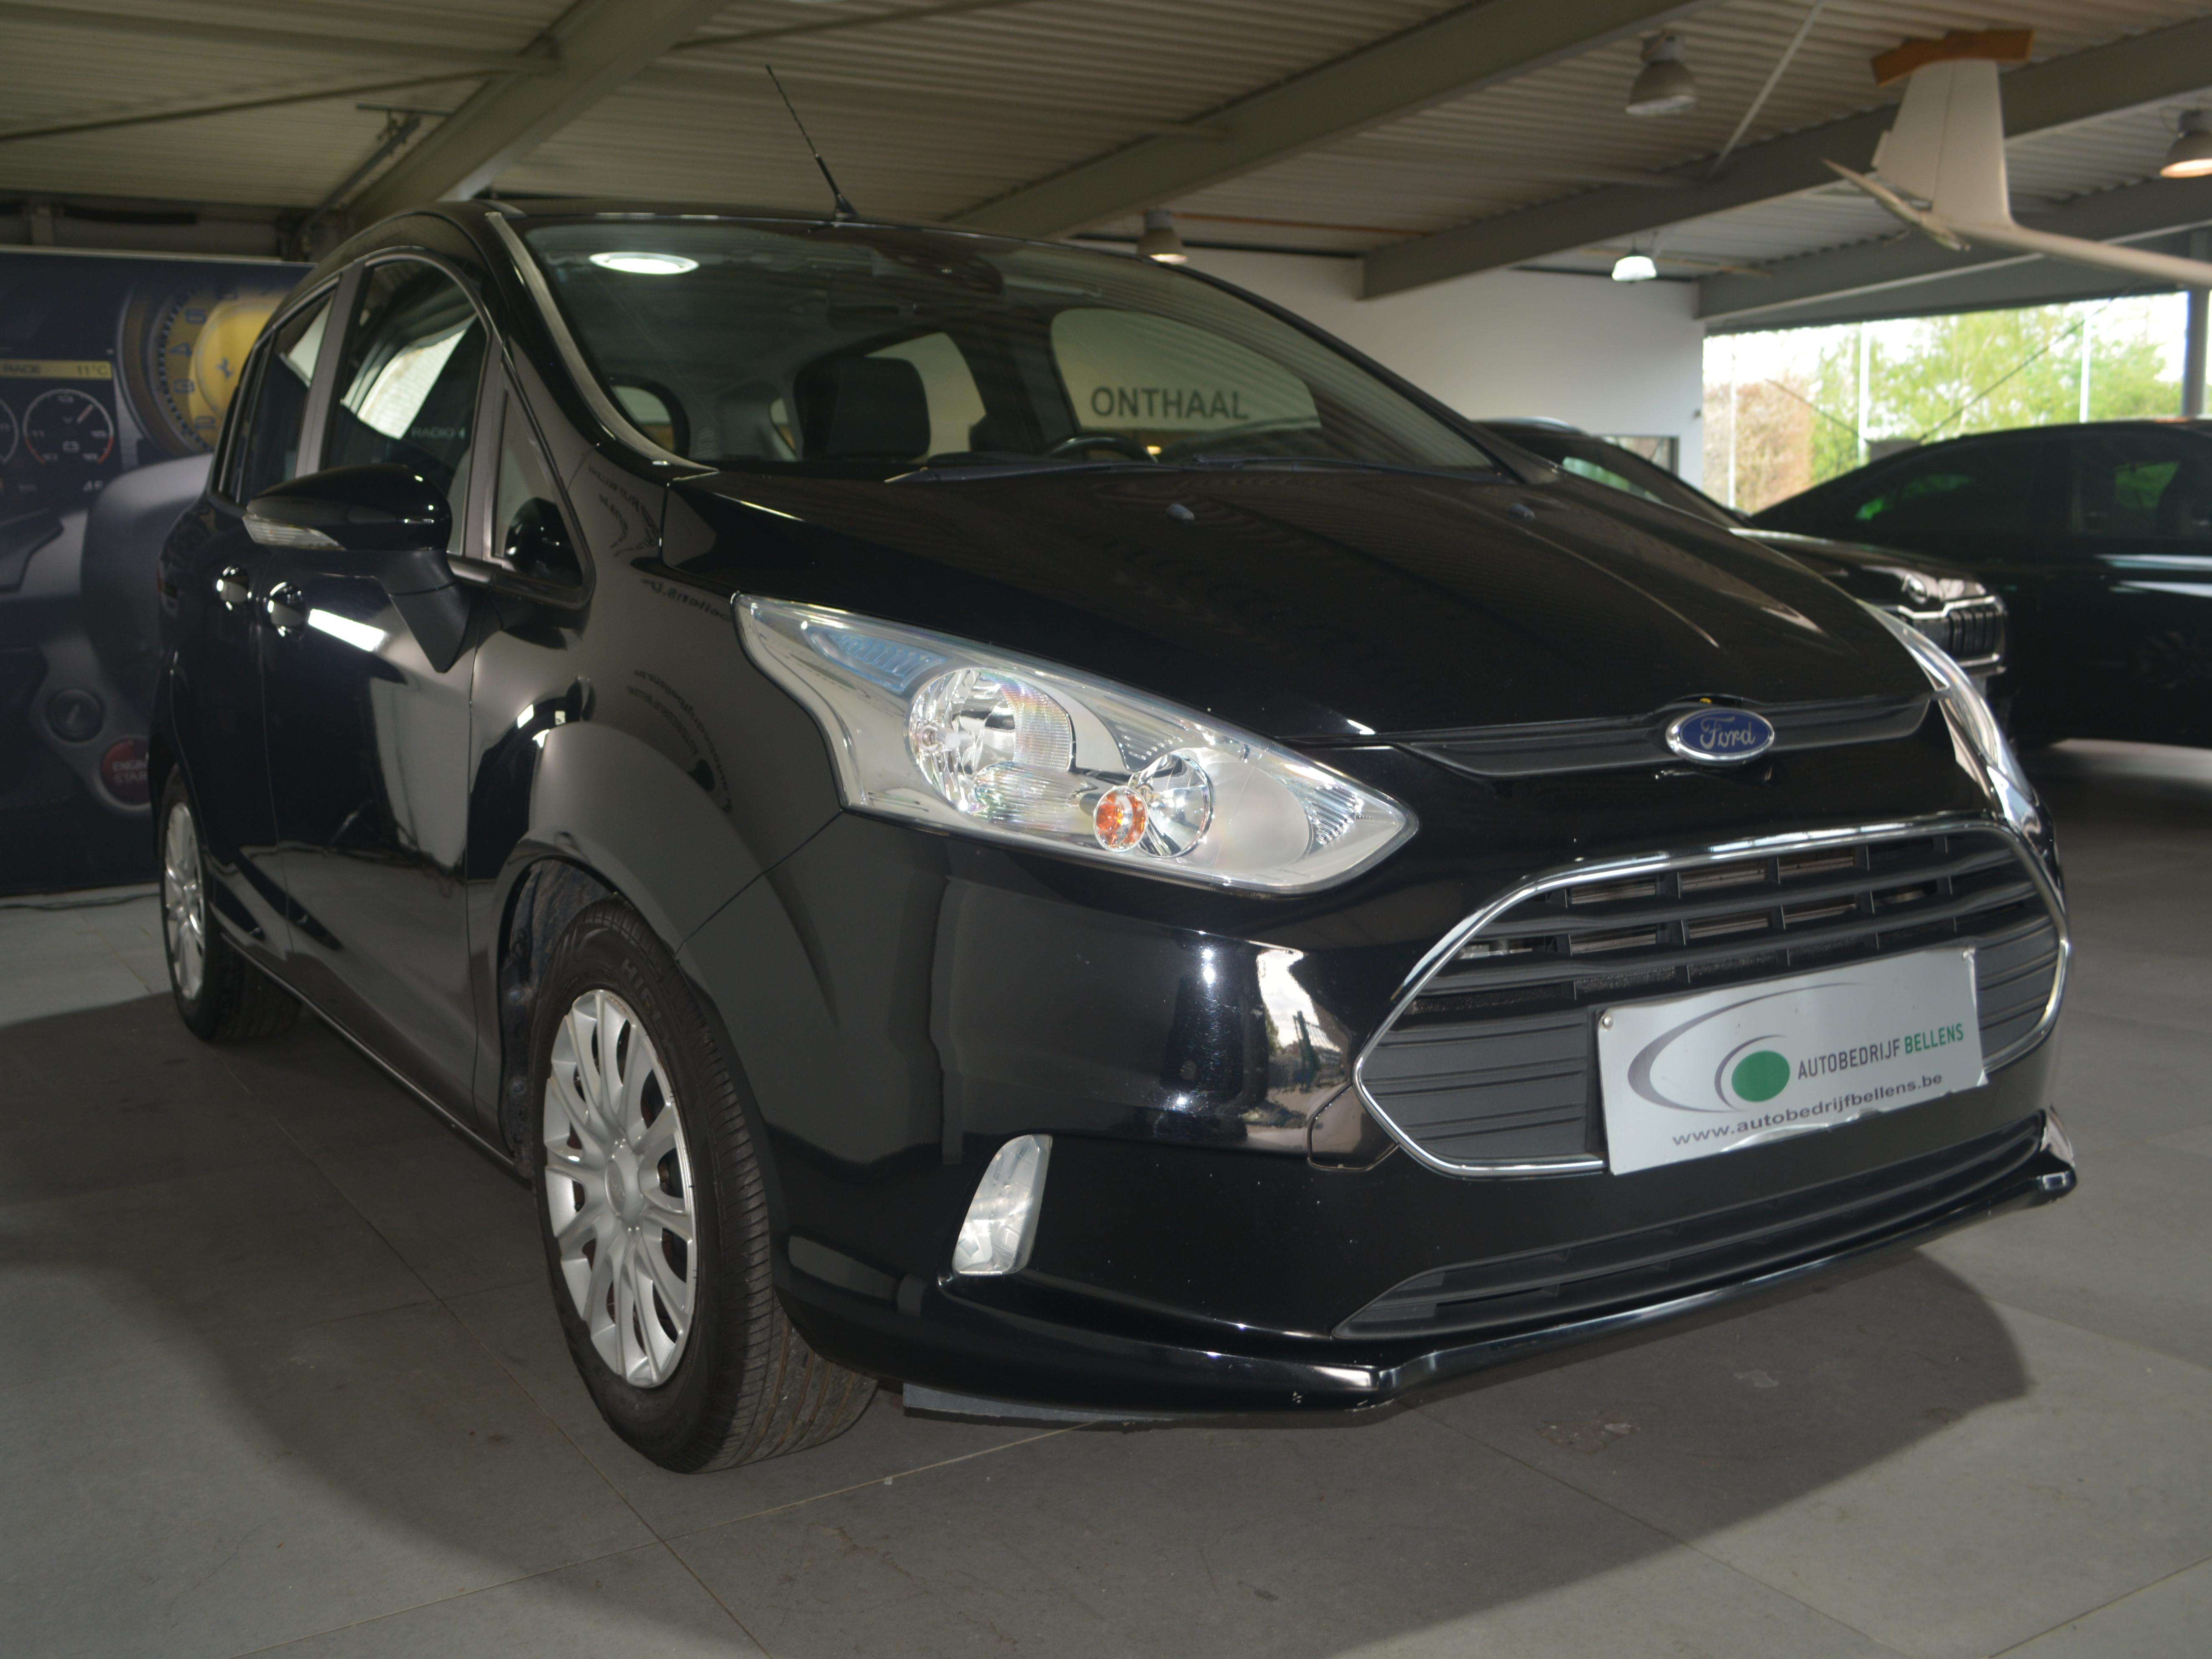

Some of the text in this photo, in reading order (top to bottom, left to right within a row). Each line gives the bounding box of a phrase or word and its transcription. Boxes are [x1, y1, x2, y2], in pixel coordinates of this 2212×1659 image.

[170, 342, 192, 357] 4
[1091, 387, 1249, 419] ONTHAAL
[1700, 716, 1756, 750] Ford
[1797, 1023, 1965, 1080] AUTOBEDRIJF BELLENS
[1672, 1073, 1942, 1146] www.autobedrijfbellens.be
